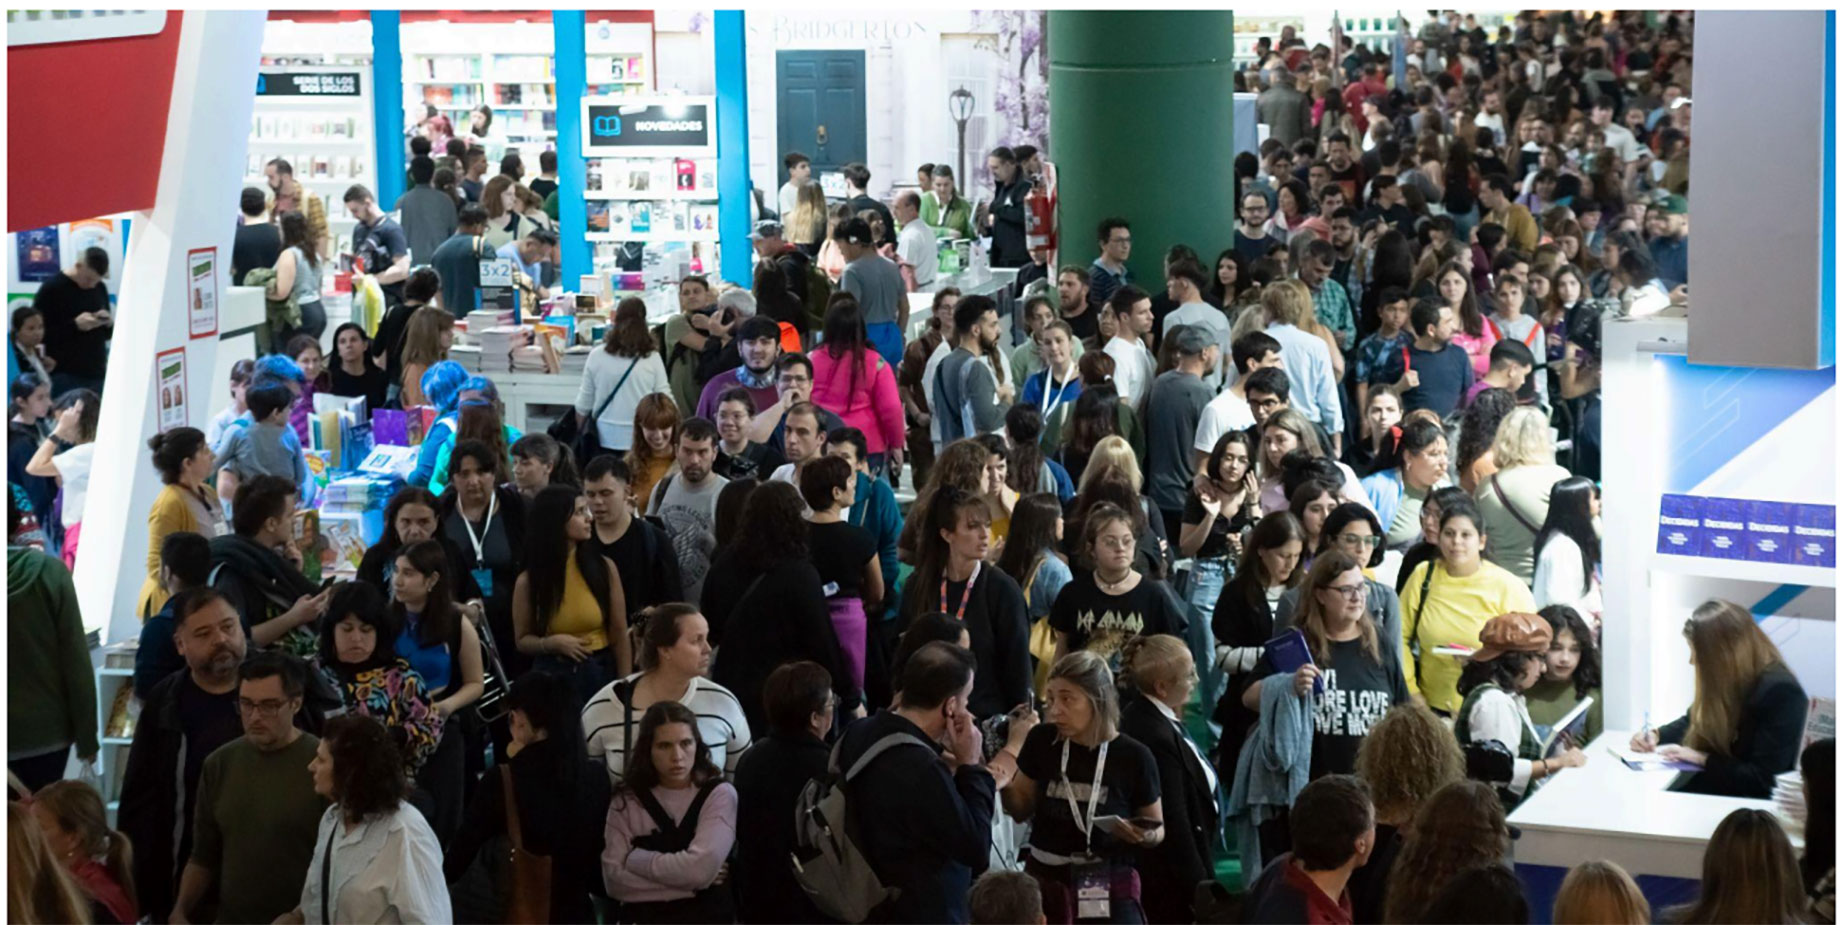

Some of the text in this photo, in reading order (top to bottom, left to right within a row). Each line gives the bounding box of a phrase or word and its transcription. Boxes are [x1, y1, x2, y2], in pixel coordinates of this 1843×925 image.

[321, 76, 335, 85] DE
[336, 76, 355, 85] LOS
[635, 121, 704, 131] NOVEDADES
[1313, 690, 1390, 721] ORE LOVE
